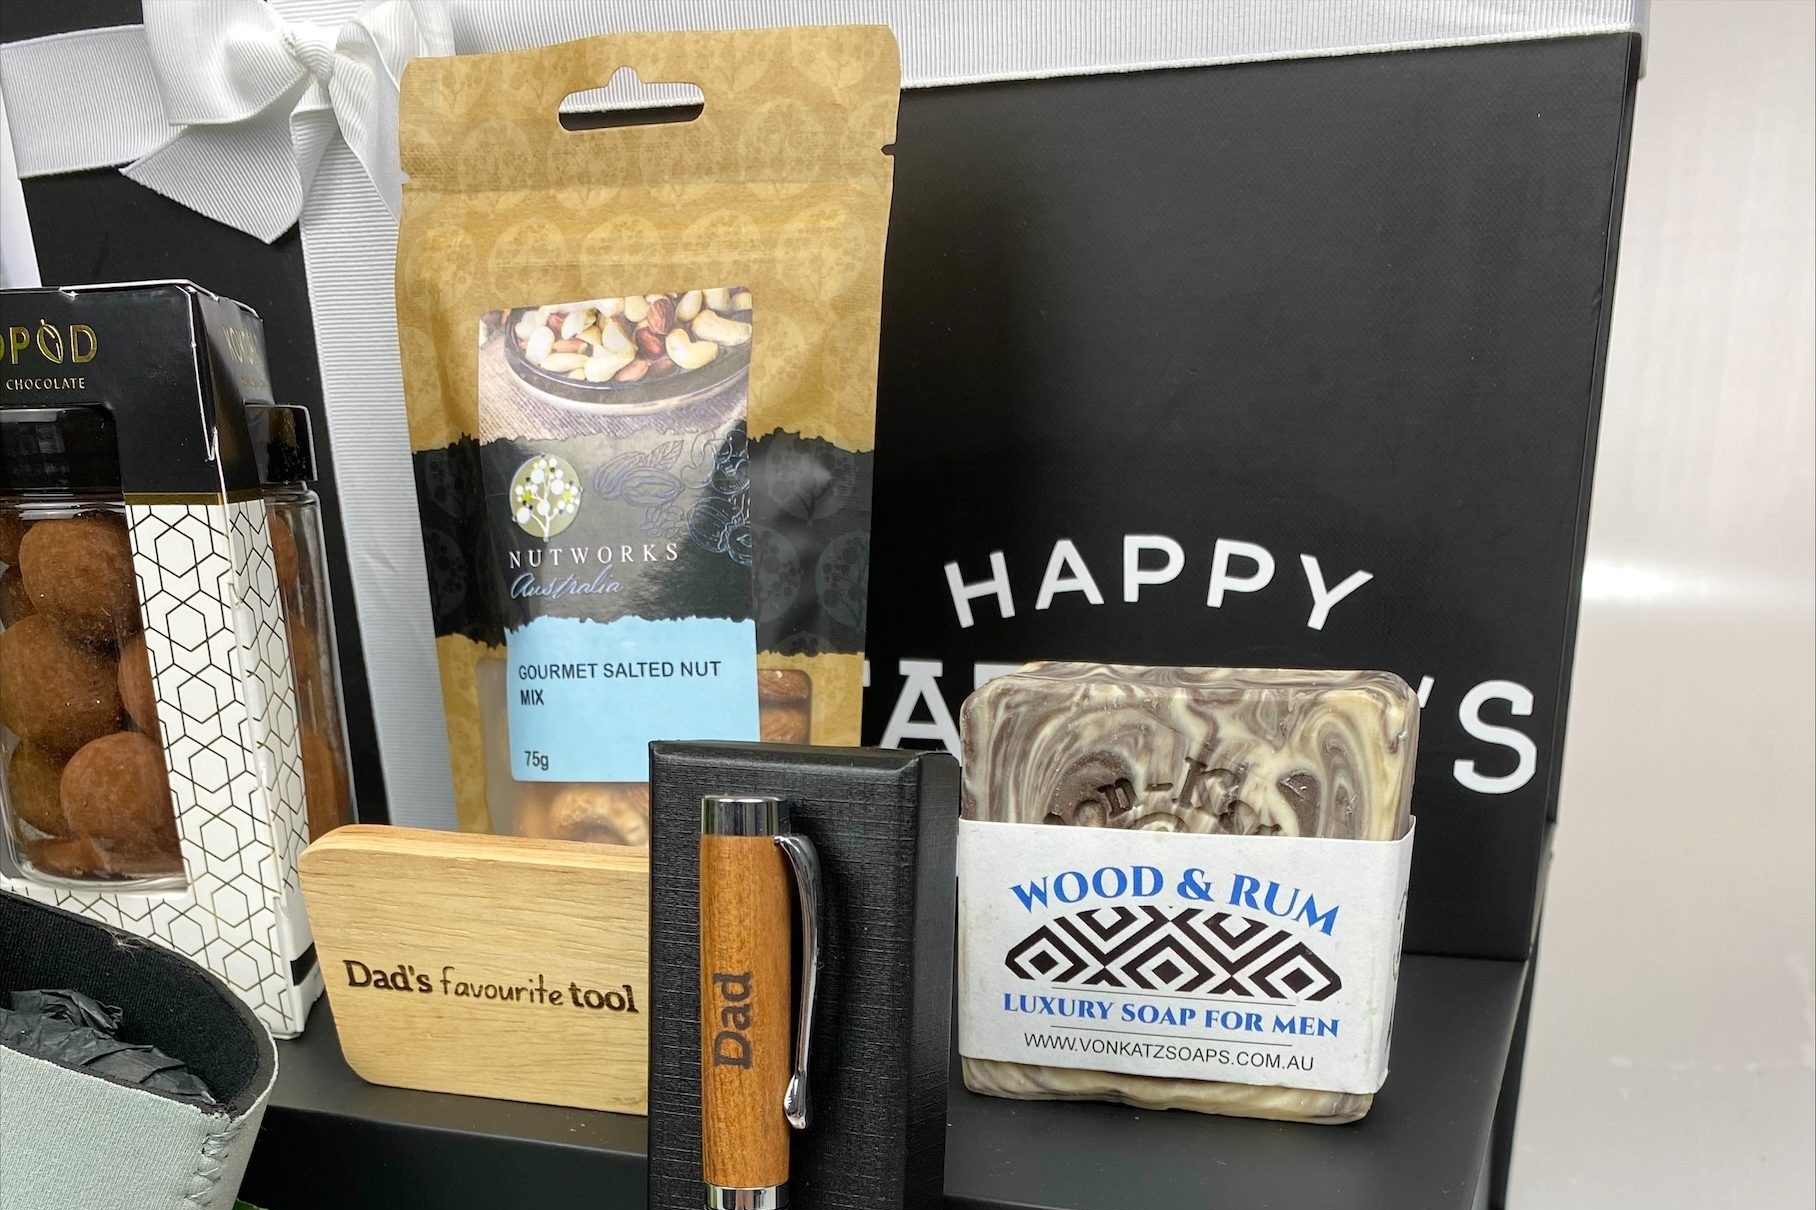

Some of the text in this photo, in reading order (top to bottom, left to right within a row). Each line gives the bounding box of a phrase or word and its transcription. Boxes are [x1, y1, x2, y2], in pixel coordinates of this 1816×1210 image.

[6, 377, 85, 391] CHOCOLATE
[508, 542, 679, 569] NUTWORKS
[510, 563, 625, 600] Australia
[944, 533, 1374, 632] HAPPY
[518, 660, 722, 681] GOURMET SALTED NUT
[520, 689, 545, 706] MIX
[524, 750, 550, 770] 75g
[1008, 865, 1340, 938] WOOD & RUM
[343, 958, 640, 1013] Dad's favourite tool
[712, 970, 754, 1071] Dad
[1002, 993, 1340, 1039] LUXURY SOAP FOR MEN
[1023, 1031, 1316, 1073] WWW.VONKATZSOAPS.COM.AU
